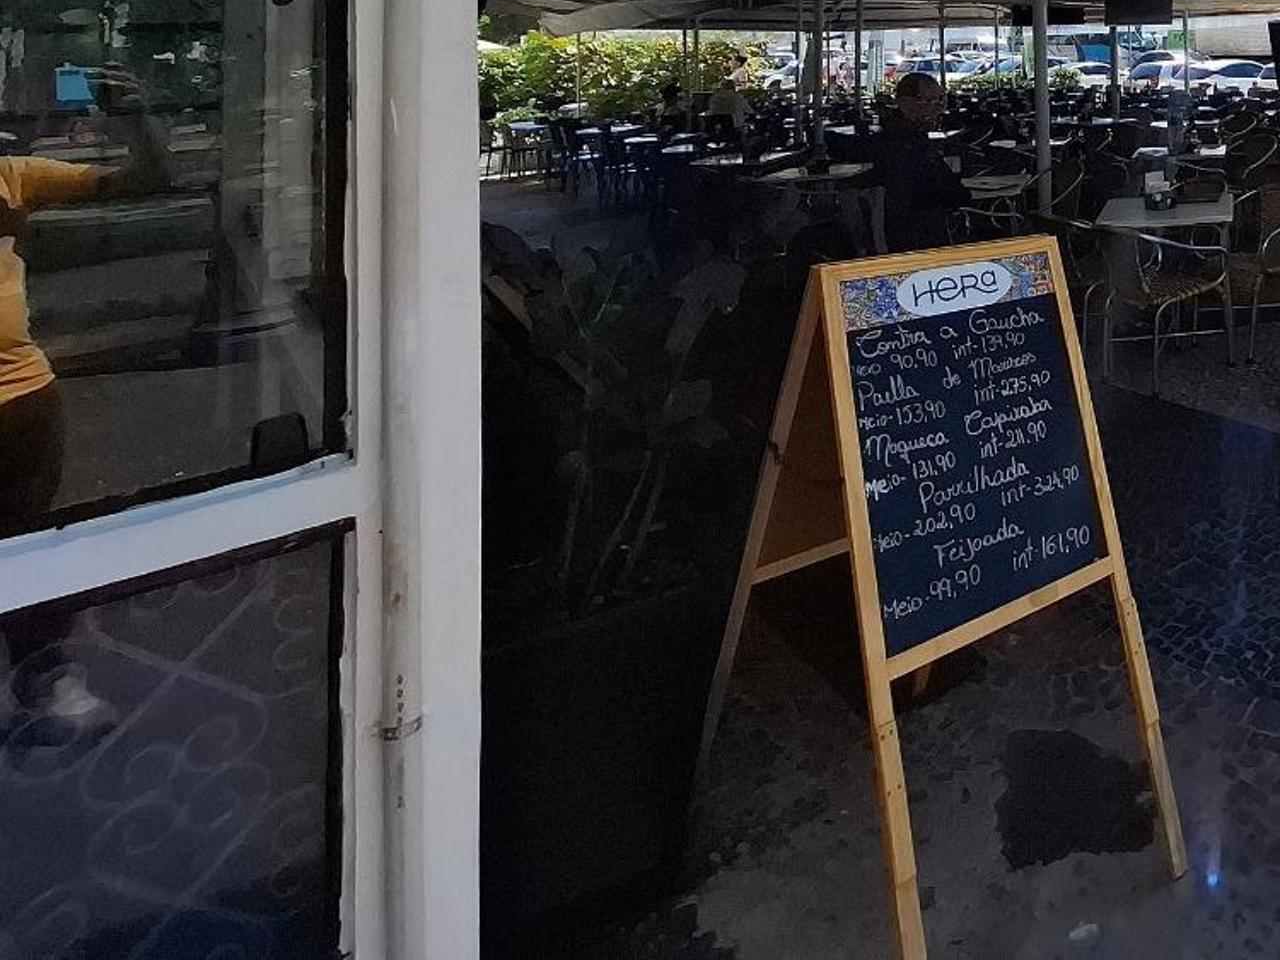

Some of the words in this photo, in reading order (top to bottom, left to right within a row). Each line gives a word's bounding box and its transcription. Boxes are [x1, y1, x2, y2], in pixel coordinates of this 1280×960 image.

[856, 324, 932, 358] Contra
[939, 326, 958, 339] a
[943, 366, 962, 389] de
[863, 432, 950, 467] Moqueca
[919, 456, 1030, 514] Parrilhada
